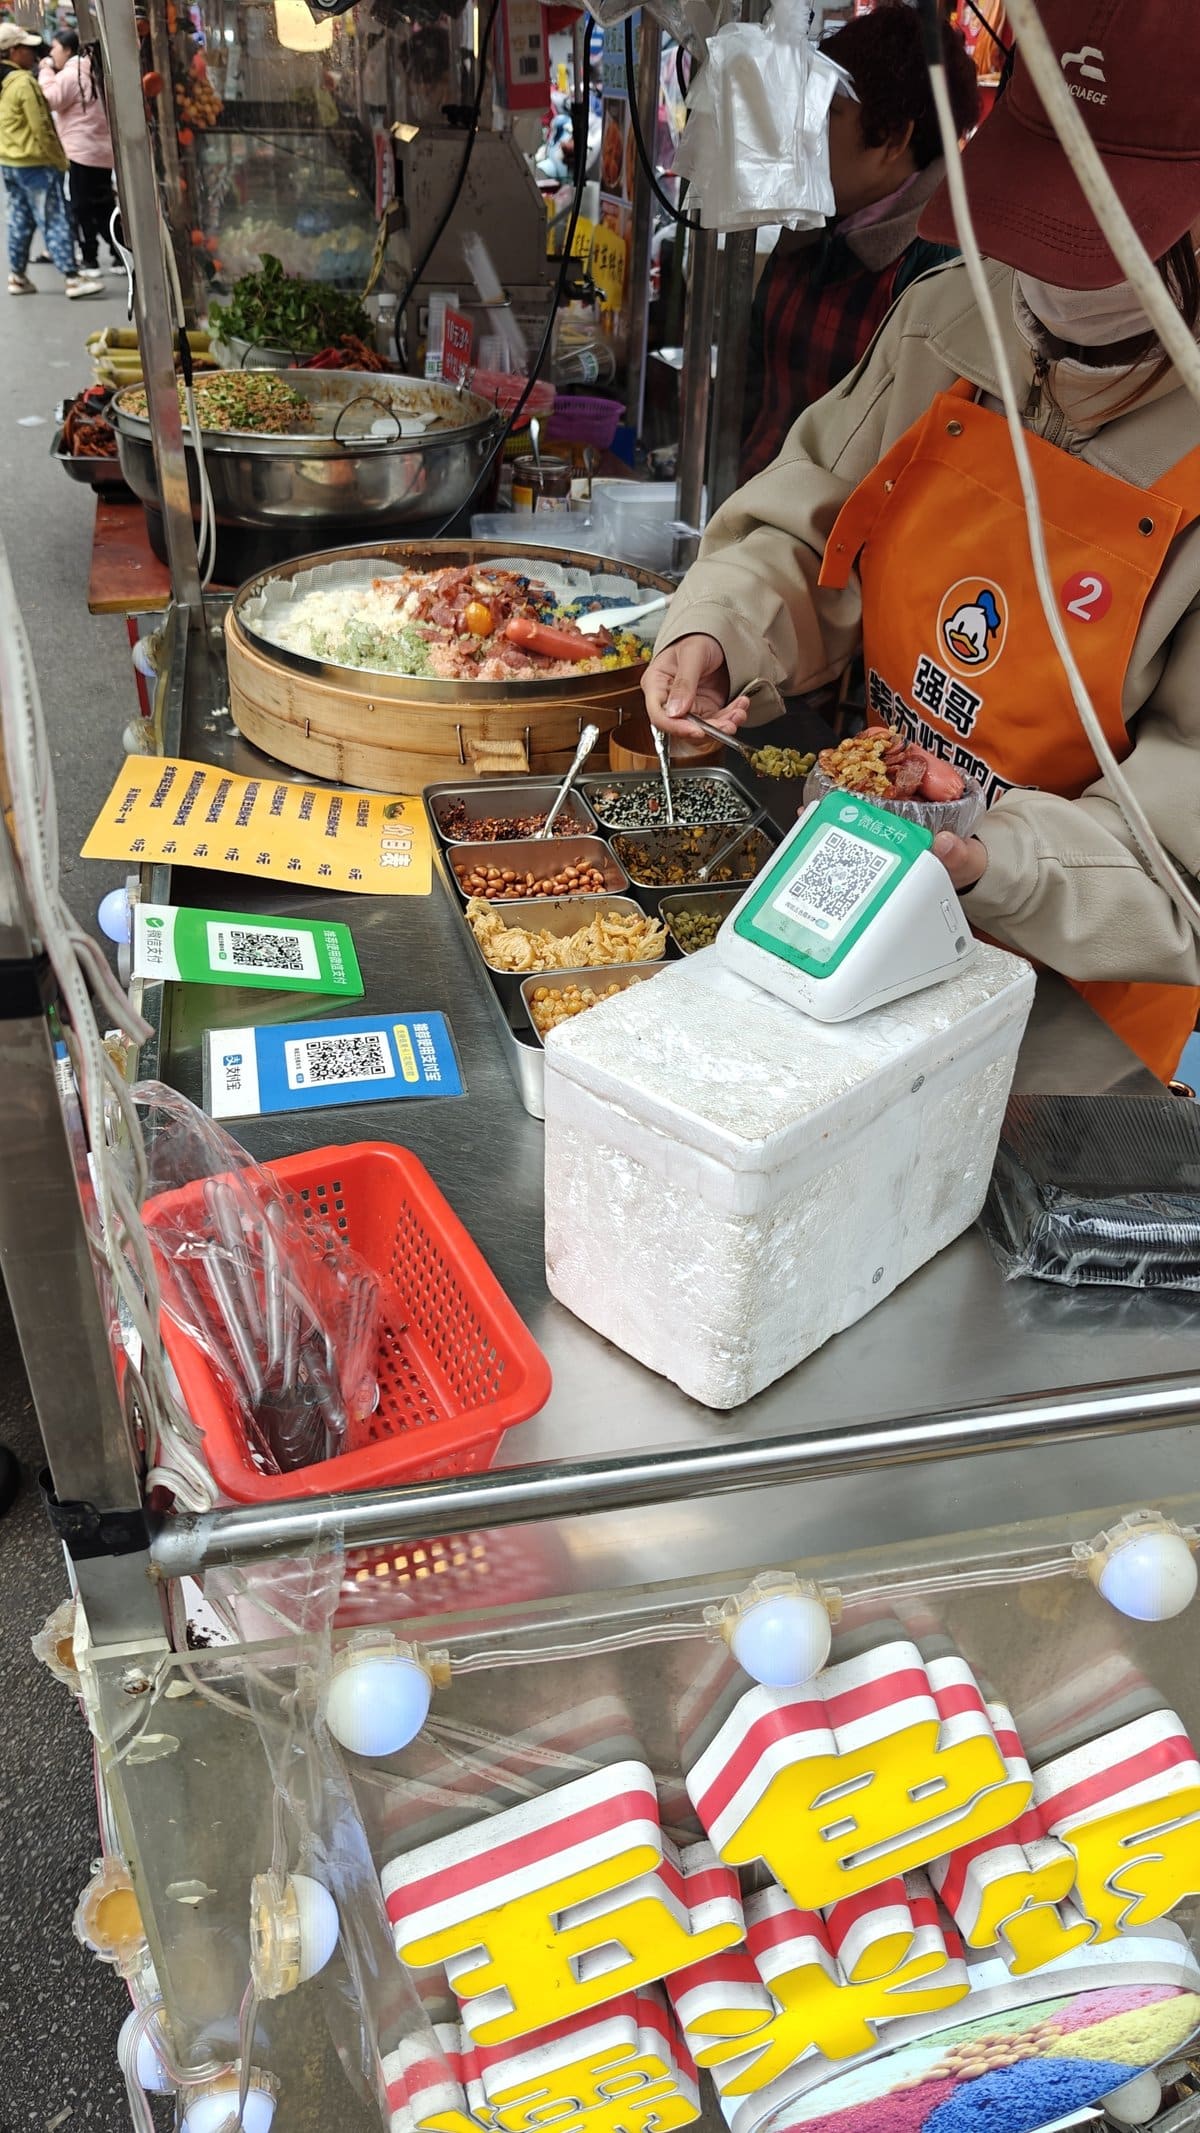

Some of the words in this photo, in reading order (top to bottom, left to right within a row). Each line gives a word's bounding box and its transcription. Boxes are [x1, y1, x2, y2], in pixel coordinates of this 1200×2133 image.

[1067, 576, 1102, 621] 2
[912, 655, 982, 738] 强哥
[857, 814, 908, 844] 微信支付
[130, 838, 145, 852] 15元
[162, 840, 176, 853] 11元
[194, 843, 208, 857] 11元
[225, 848, 239, 861] 11元
[380, 824, 413, 867] 价目表
[257, 852, 270, 864] 9元
[288, 858, 300, 870] 9元
[318, 864, 331, 875] 9元
[349, 868, 361, 880] 6元
[146, 929, 164, 964] 微信支付
[322, 929, 347, 985] 推荐使用微信支付
[413, 1023, 442, 1082] 推荐使用支付宝
[225, 1066, 242, 1091] 支付宝
[398, 1718, 1034, 2047] 五色
